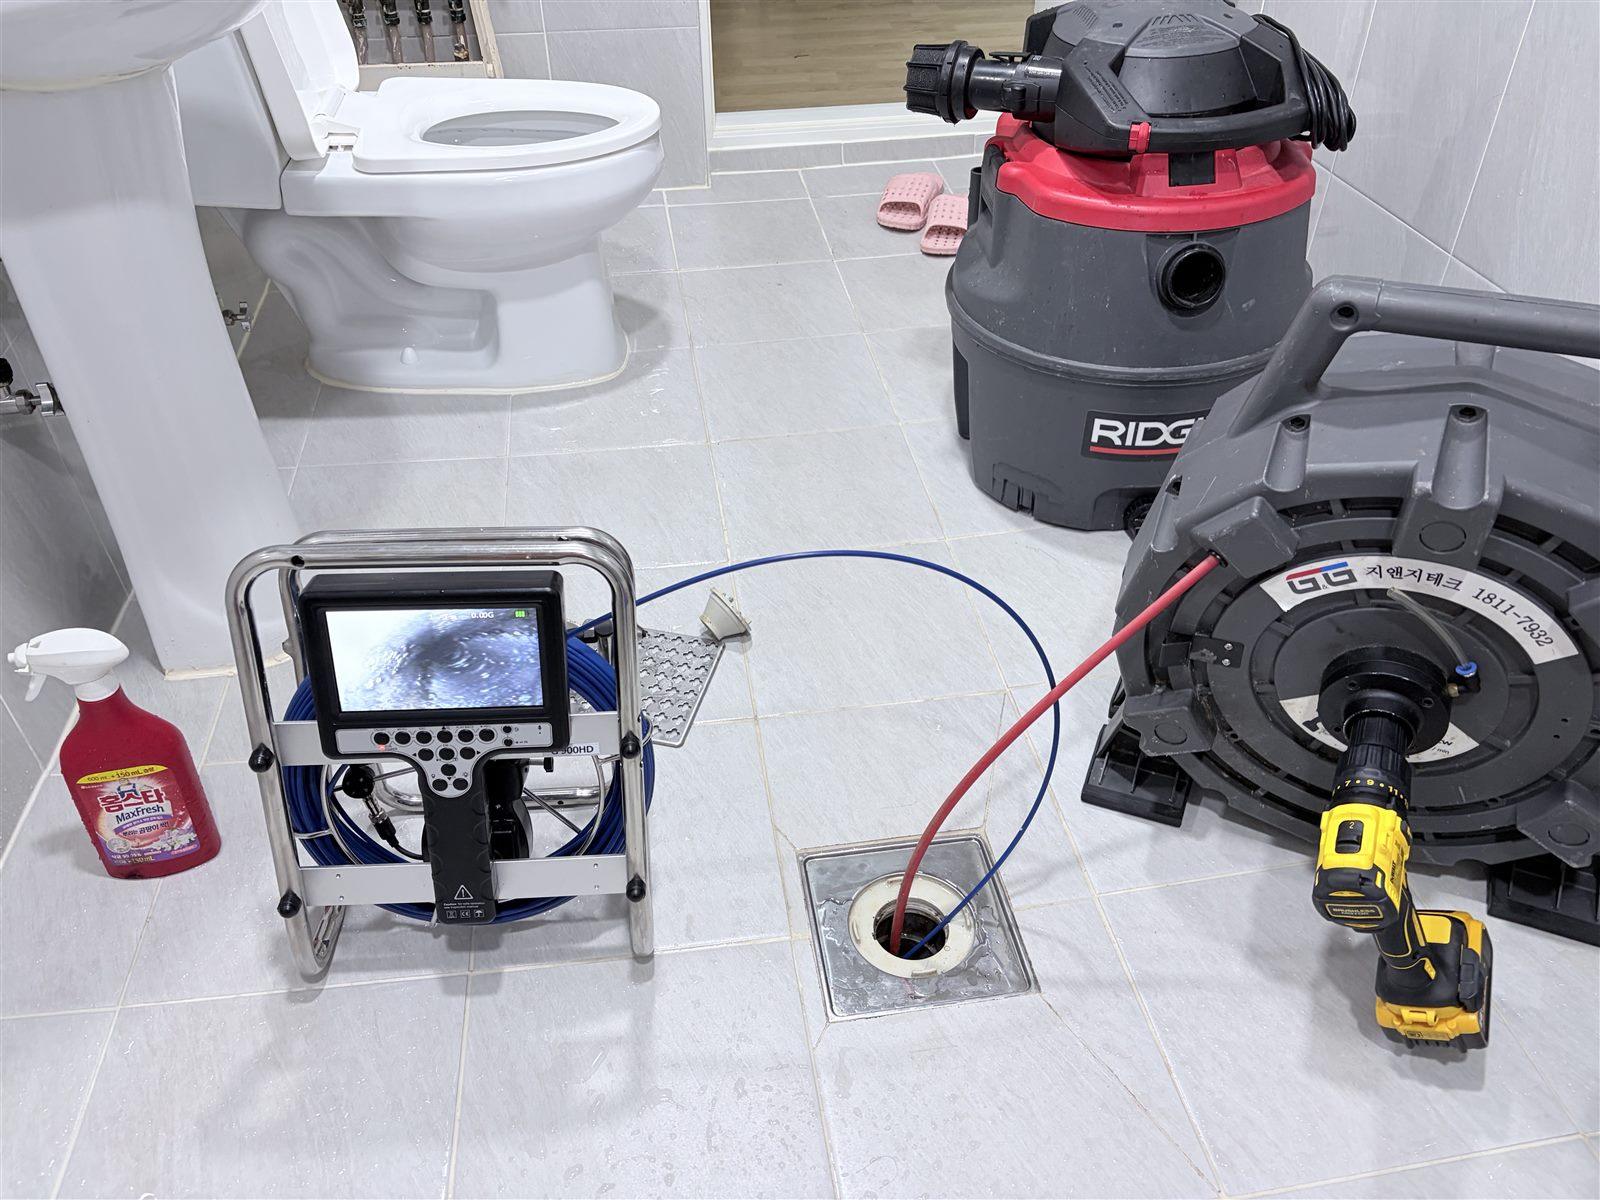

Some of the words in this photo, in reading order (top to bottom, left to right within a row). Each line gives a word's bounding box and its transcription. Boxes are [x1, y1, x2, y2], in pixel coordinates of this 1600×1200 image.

[1090, 417, 1205, 447] RIDG
[1365, 564, 1464, 592] 지앤지테크
[1472, 587, 1554, 647] 1811-7932
[1345, 779, 1352, 787] 7
[1387, 785, 1399, 796] 11
[98, 787, 166, 813] 홈스타
[115, 804, 165, 824] MaxFresh
[1348, 821, 1356, 830] 2
